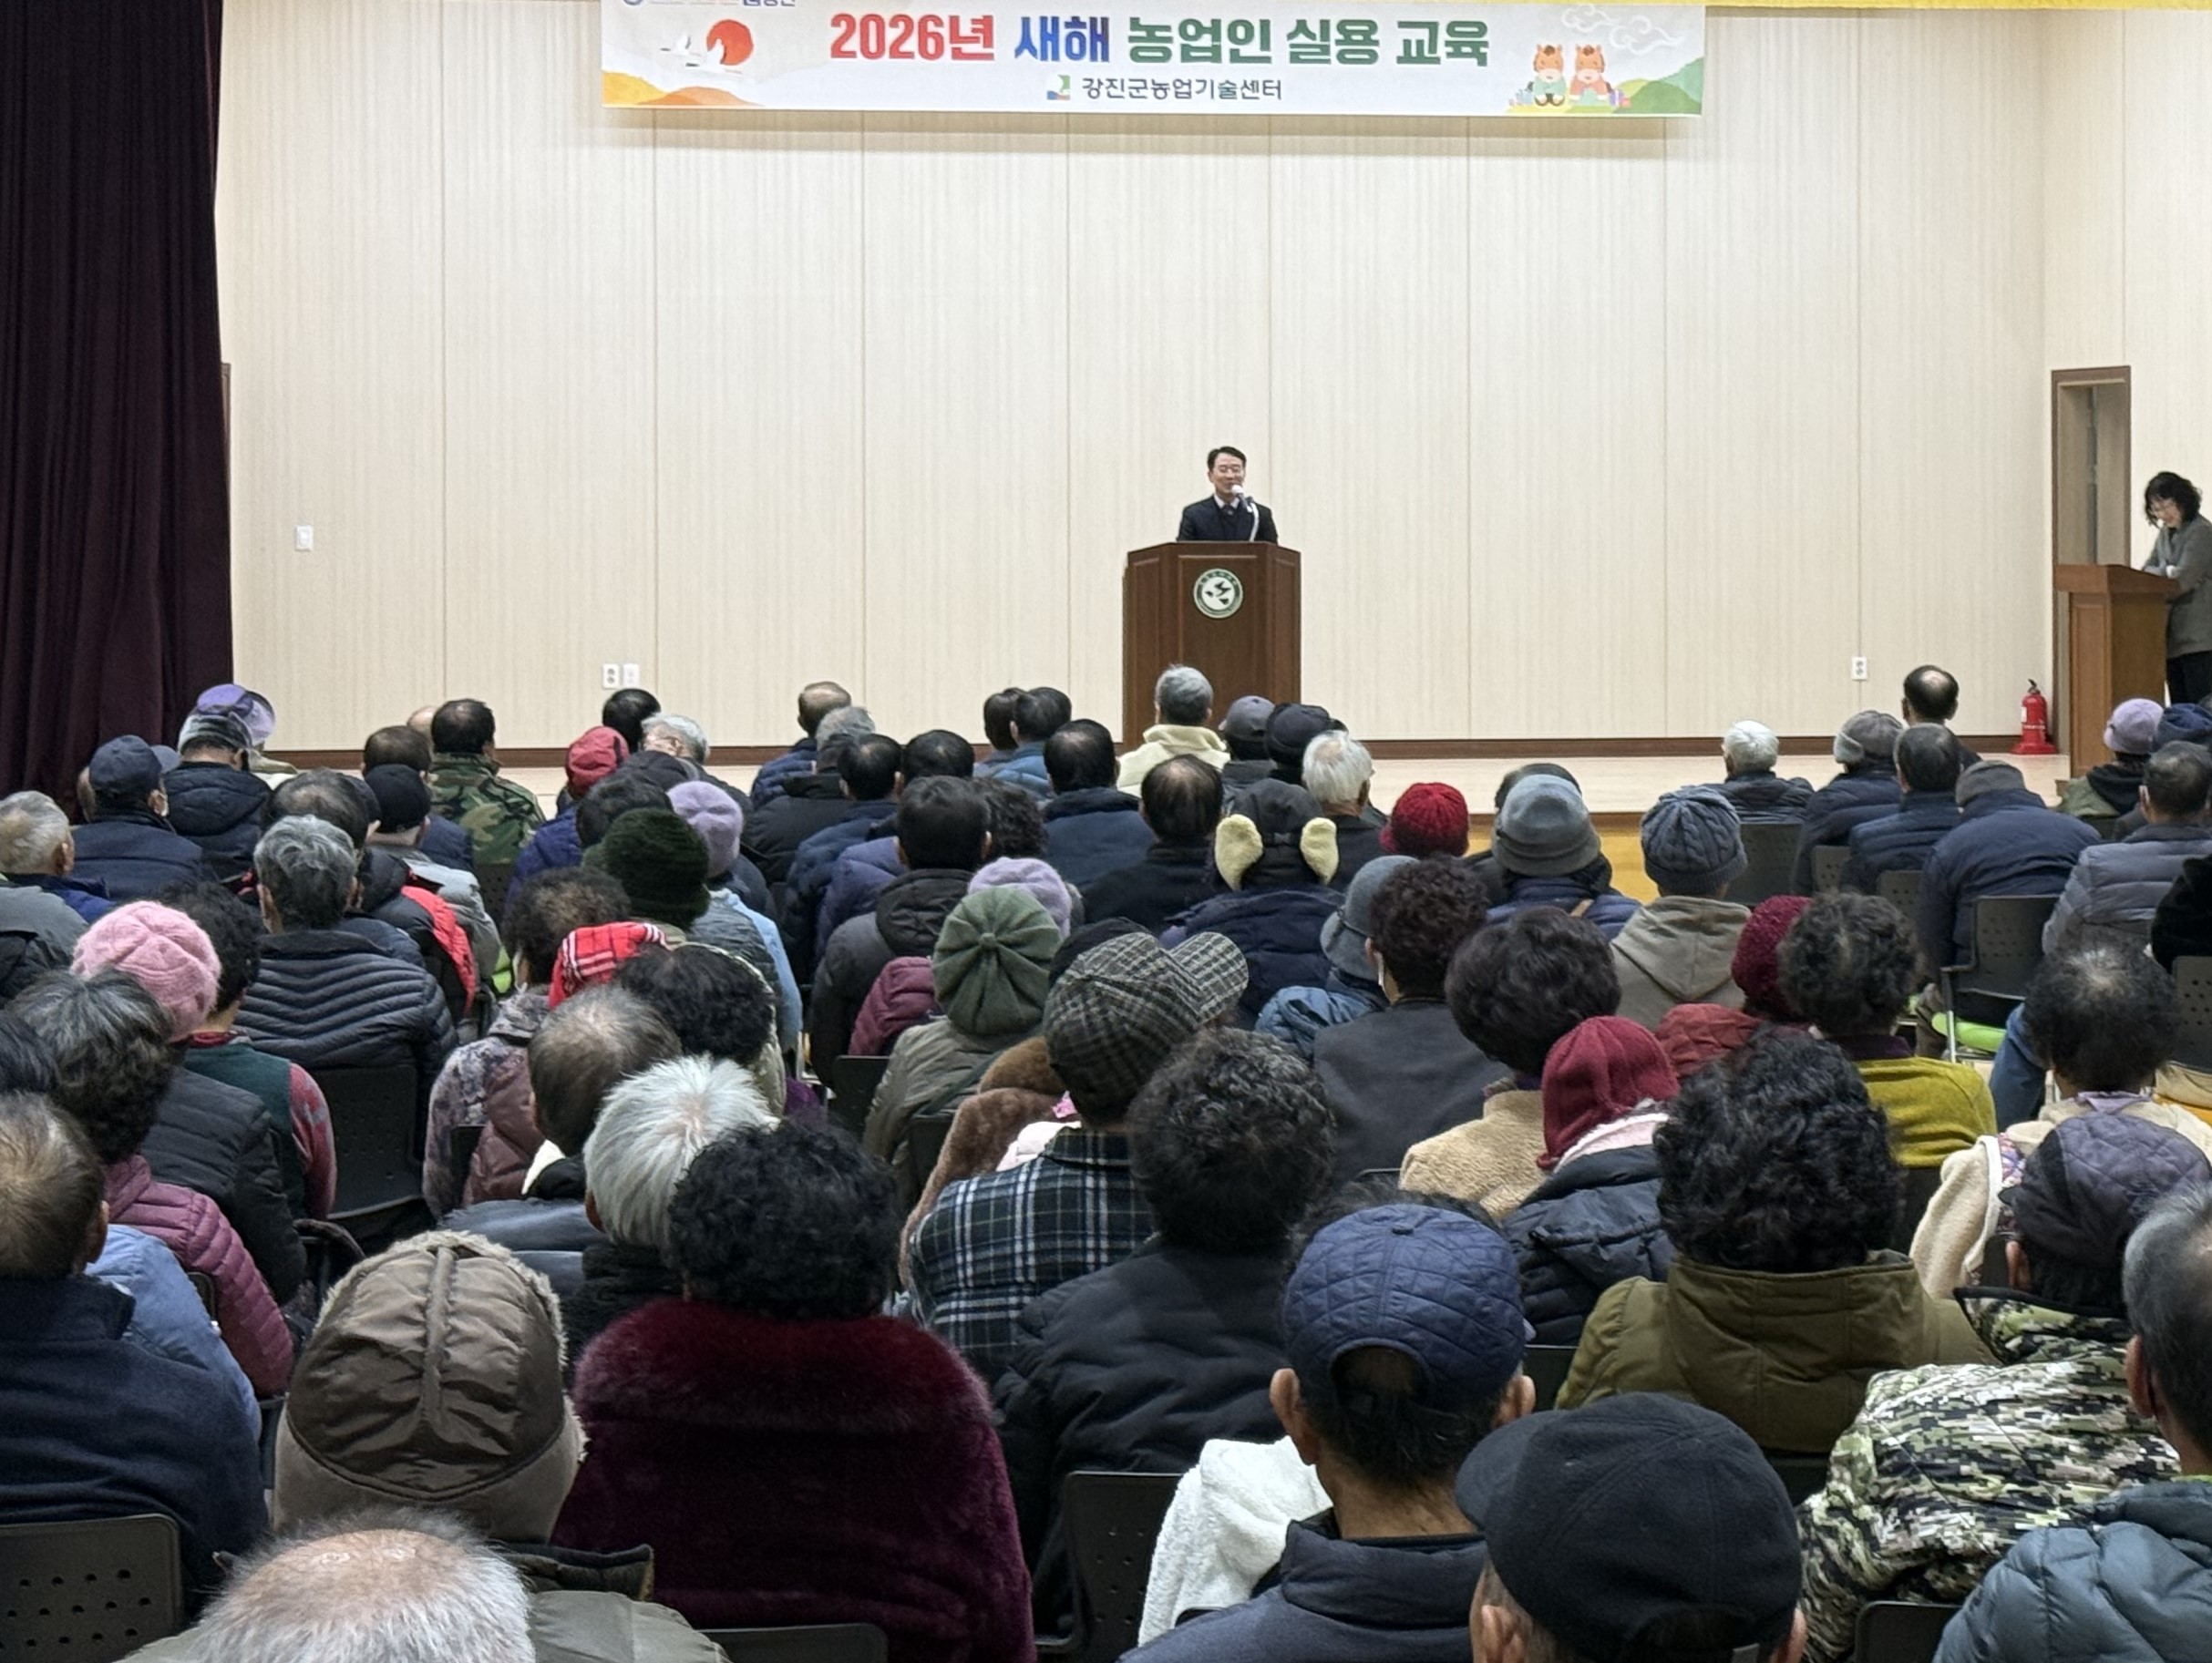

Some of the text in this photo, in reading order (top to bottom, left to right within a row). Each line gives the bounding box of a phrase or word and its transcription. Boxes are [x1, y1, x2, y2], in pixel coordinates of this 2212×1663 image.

[829, 13, 1489, 67] 2026년 새해 농업인 실용 교육
[1082, 77, 1282, 100] 강진군농업기술센터
